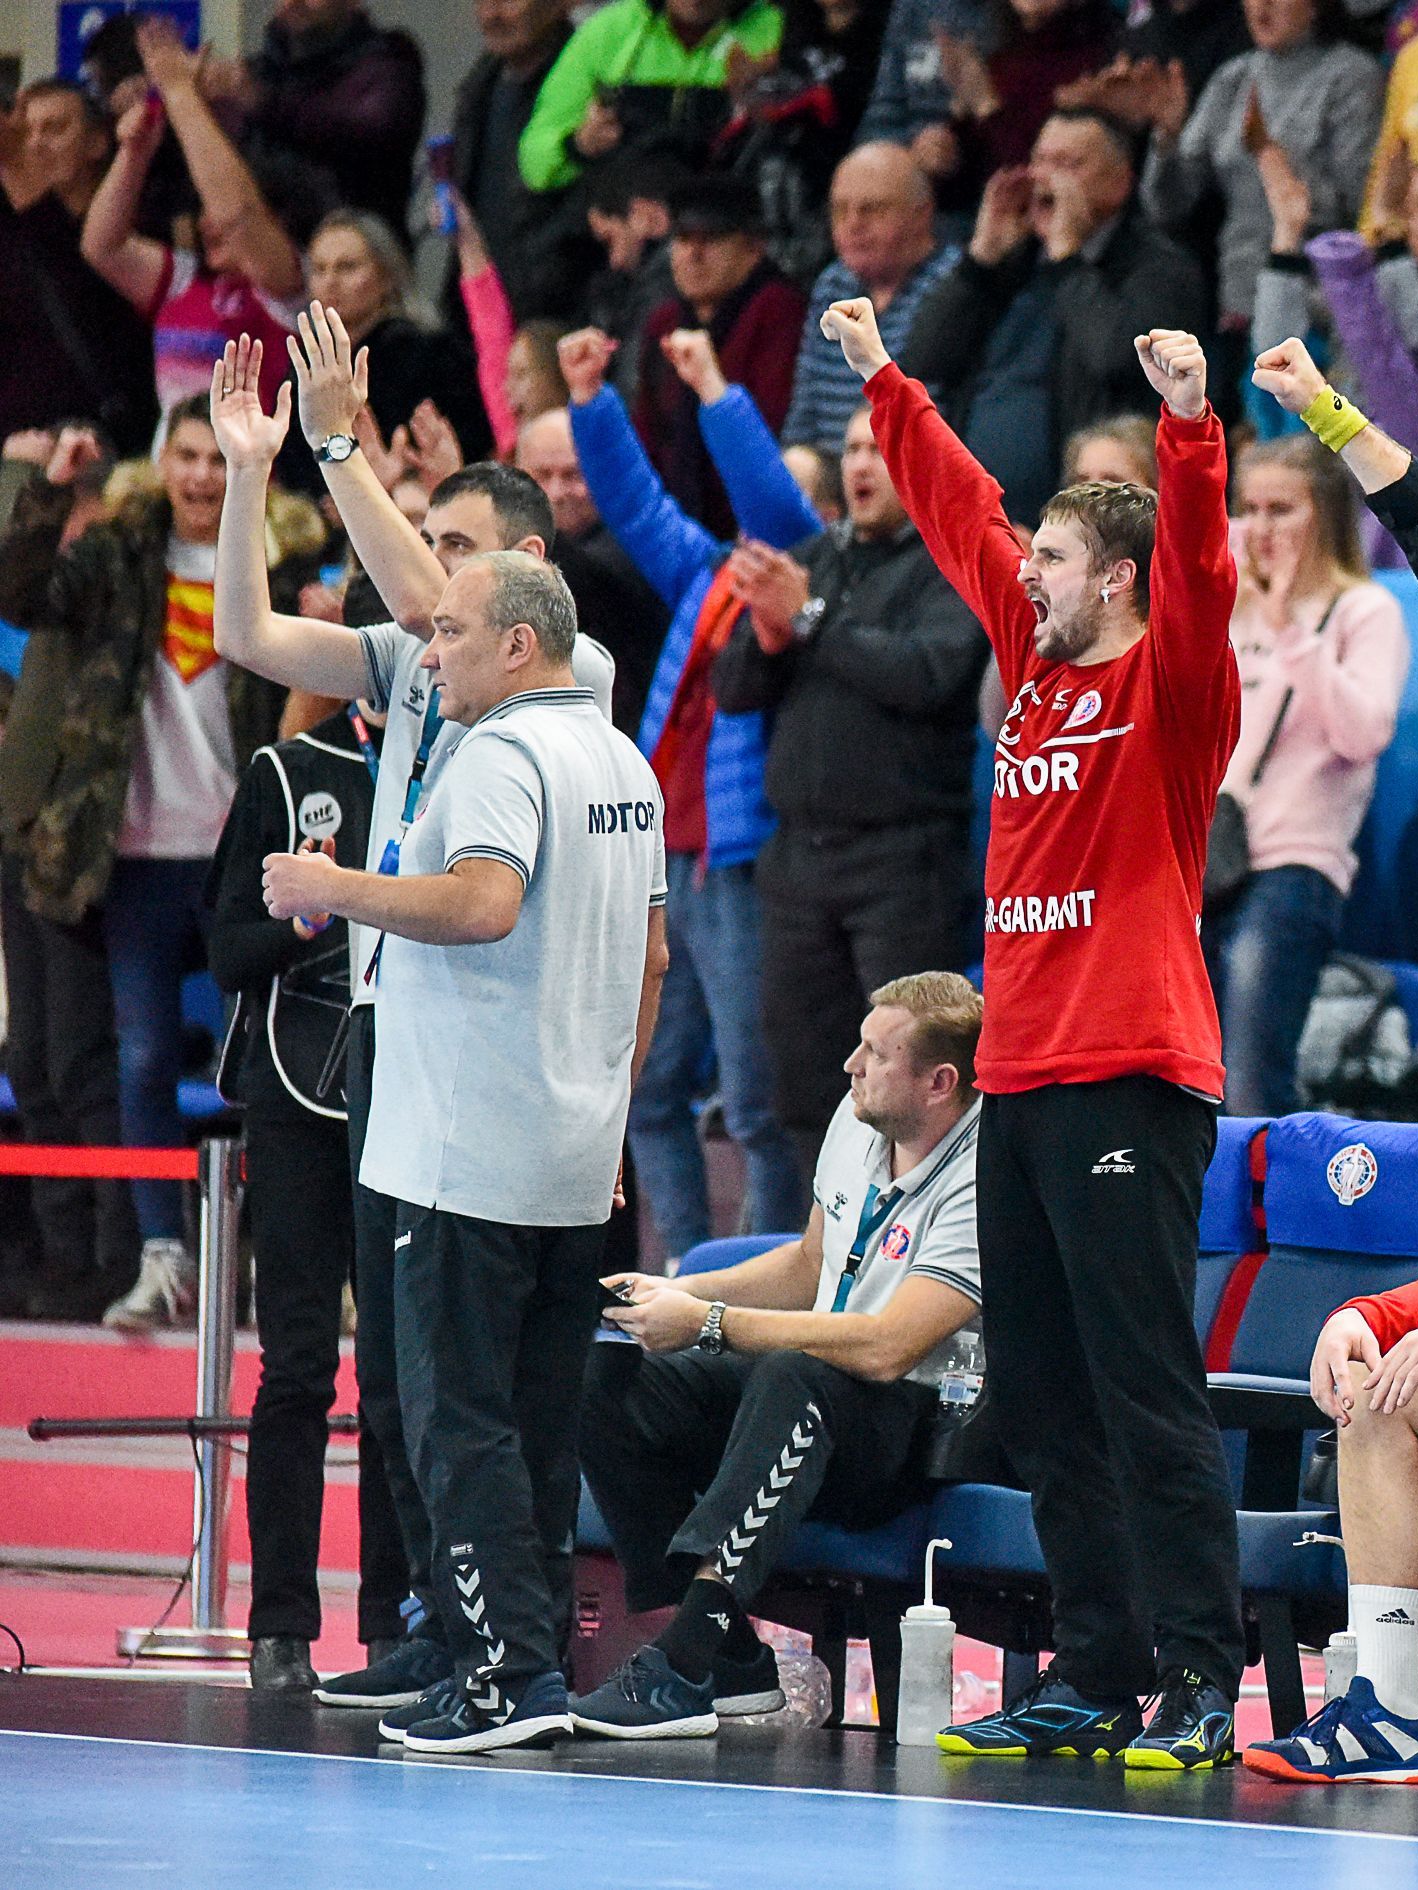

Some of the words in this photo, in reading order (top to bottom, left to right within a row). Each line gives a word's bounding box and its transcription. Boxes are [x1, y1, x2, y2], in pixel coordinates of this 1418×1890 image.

[994, 752, 1080, 798] OTOR
[985, 889, 1096, 933] R-GARANT
[1375, 1617, 1415, 1626] adidas
